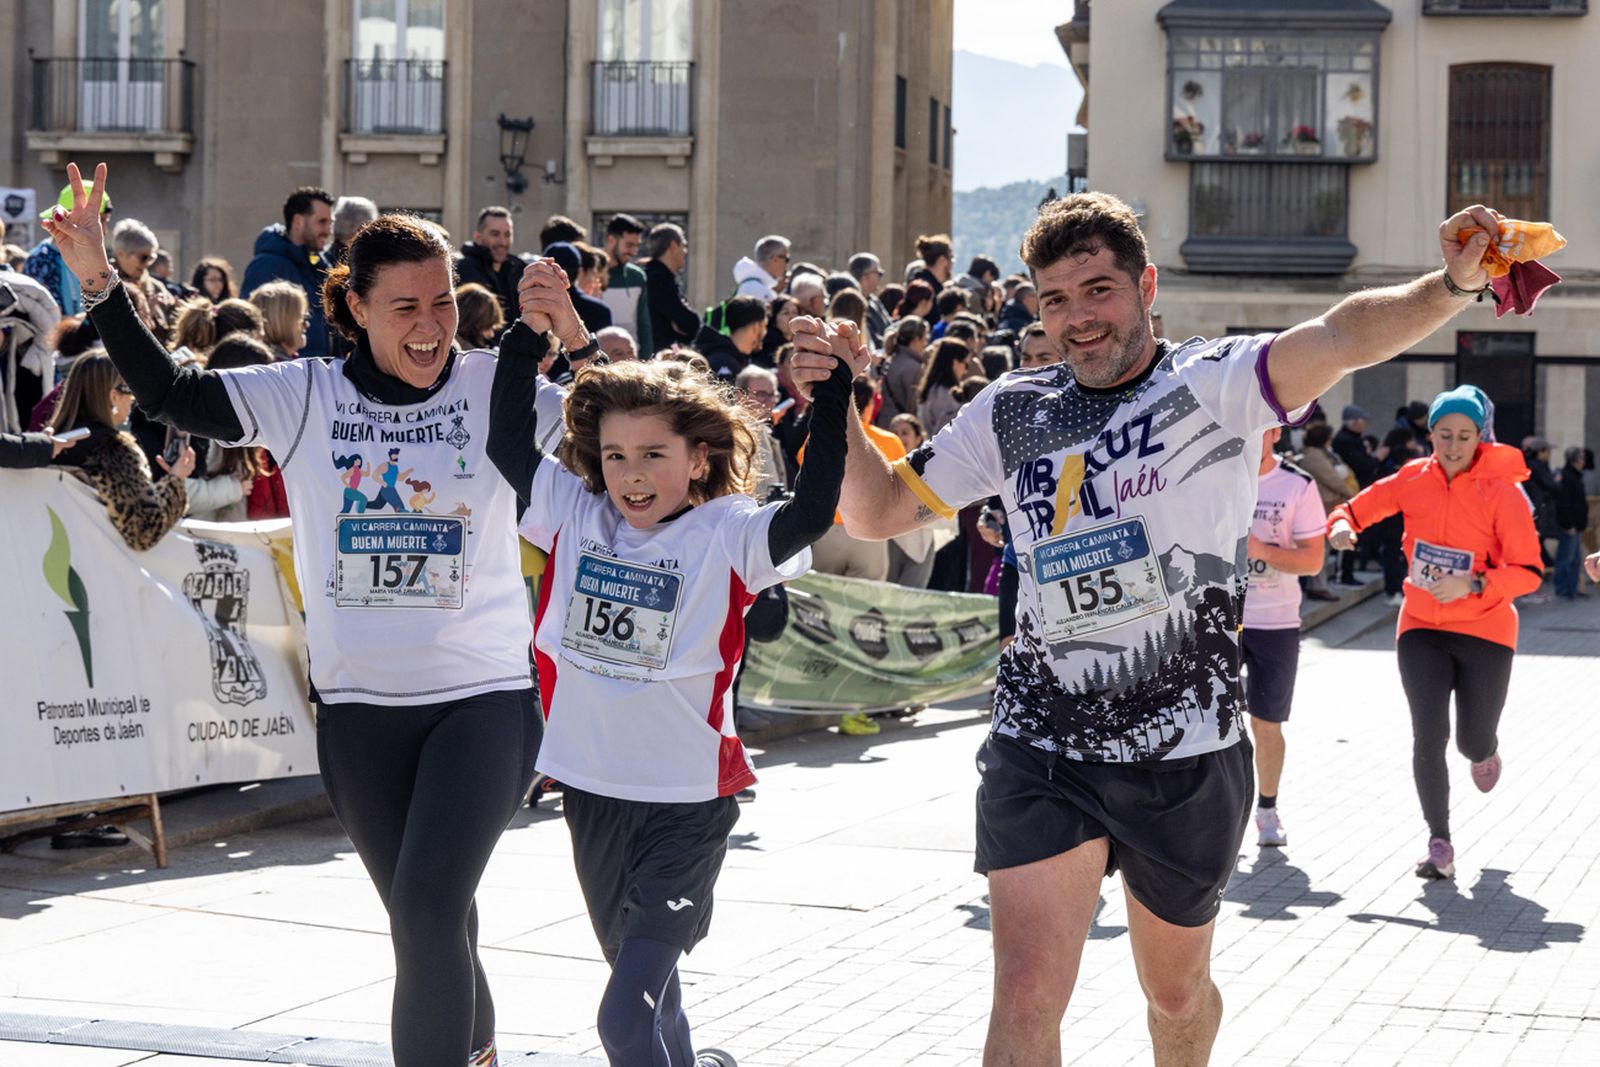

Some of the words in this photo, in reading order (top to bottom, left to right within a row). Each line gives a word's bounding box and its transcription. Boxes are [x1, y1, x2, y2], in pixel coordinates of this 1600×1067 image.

[334, 400, 346, 415] VI
[348, 402, 402, 424] CARRERA
[405, 398, 469, 423] CAMINATA
[331, 420, 375, 442] BUENA
[380, 423, 445, 444] MUERTE
[1020, 462, 1115, 541] TRAIL
[1113, 464, 1168, 519] Jaén
[351, 522, 361, 532] VI
[362, 521, 401, 532] CARRERA
[402, 522, 449, 533] CAMINATA
[351, 536, 385, 550] BUENA
[387, 535, 428, 550] MUERTE
[1045, 542, 1081, 557] CARRERA
[1081, 528, 1130, 549] CAMINATA
[370, 555, 429, 588] 157
[1042, 561, 1069, 579] BUENA
[1070, 547, 1114, 571] MUERTE
[601, 580, 641, 602] MUERTE
[618, 570, 665, 588] CAMINATA
[1060, 568, 1123, 615] 155
[583, 597, 635, 641] 156
[37, 700, 85, 720] Patronato
[86, 695, 137, 719] Municipal
[53, 726, 101, 749] Deportes
[103, 722, 117, 741] de
[118, 719, 144, 740] Jaén
[187, 719, 239, 742] CIUDAD
[242, 717, 261, 738] DE
[261, 712, 296, 737] JAÉN
